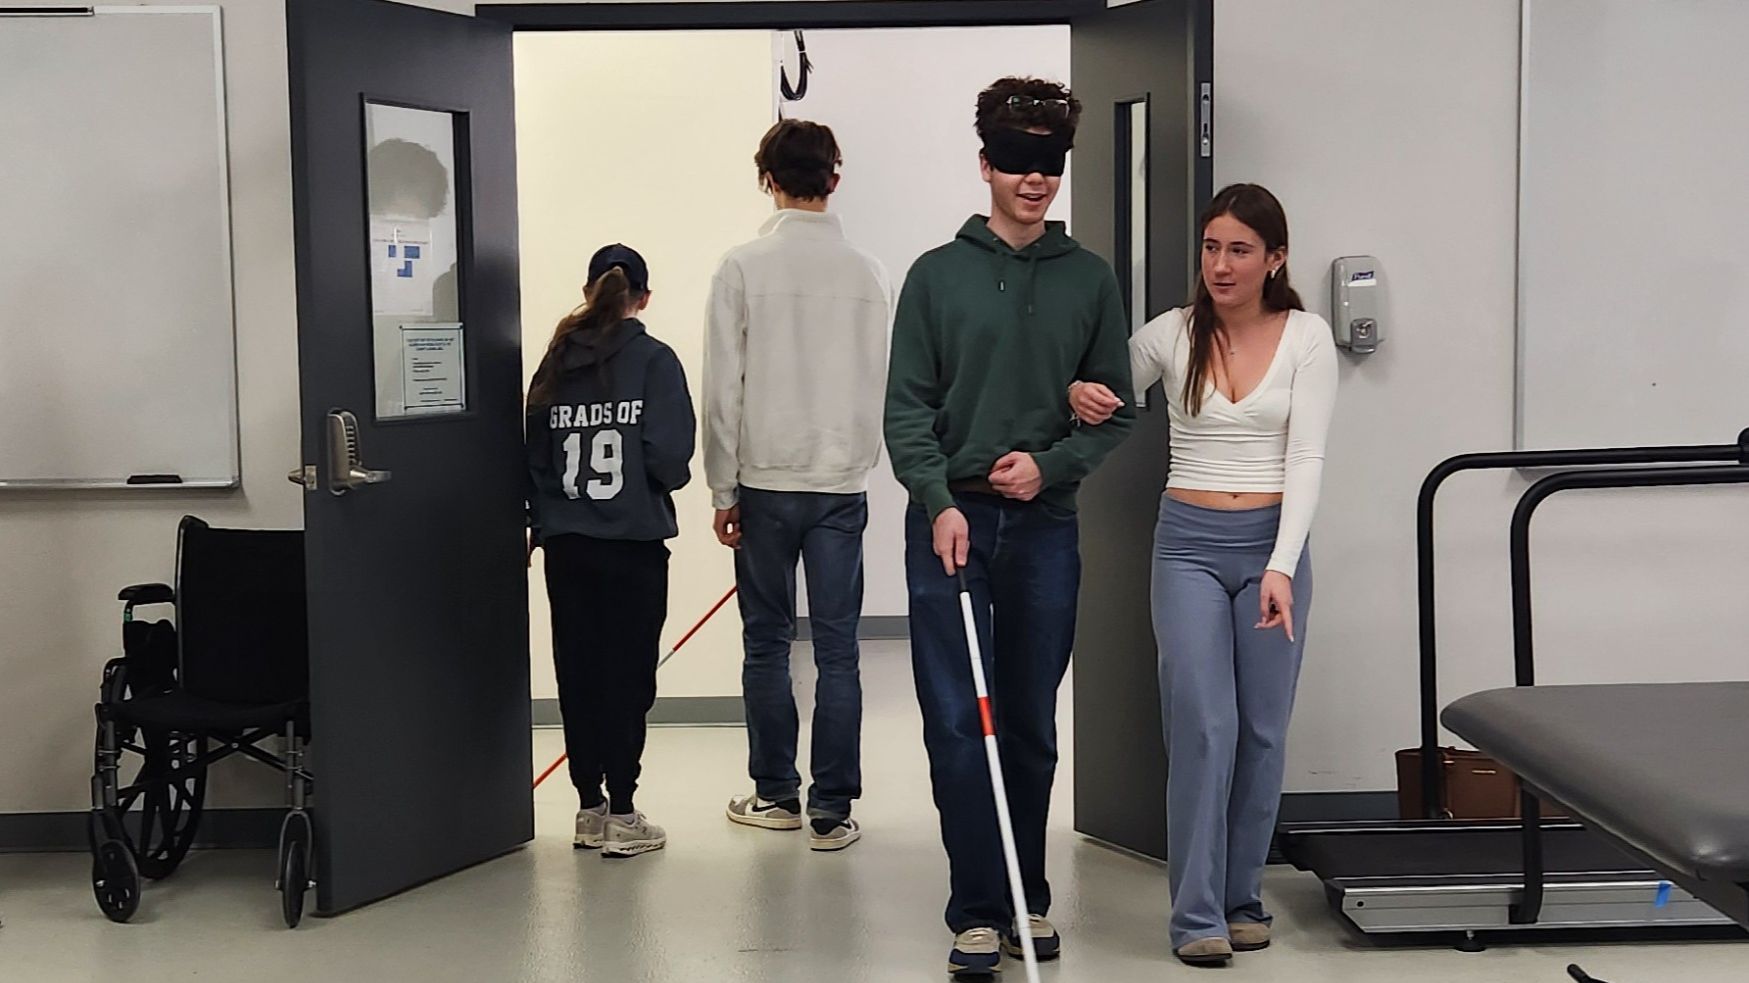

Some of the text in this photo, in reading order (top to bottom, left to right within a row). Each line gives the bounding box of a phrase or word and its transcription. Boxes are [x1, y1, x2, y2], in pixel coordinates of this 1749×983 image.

[549, 400, 643, 429] GRADS OF
[562, 429, 623, 500] 19
